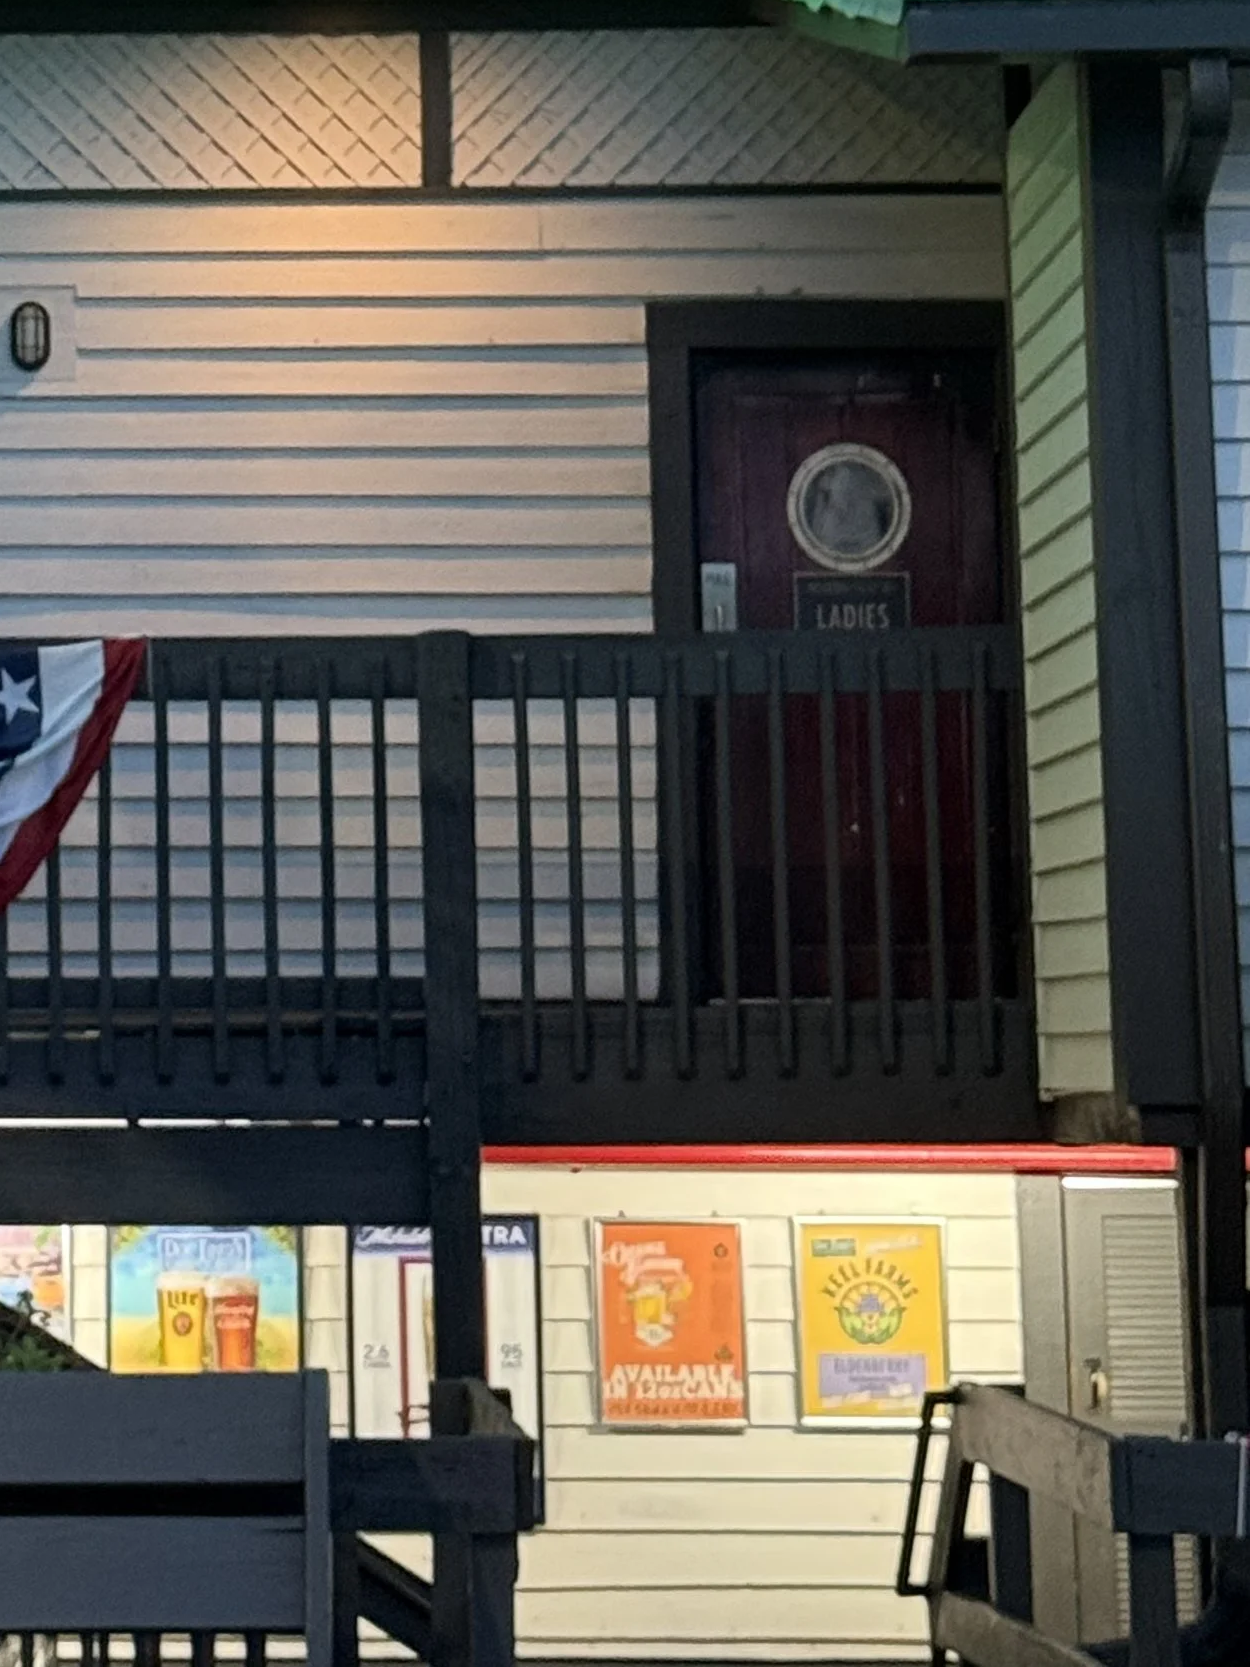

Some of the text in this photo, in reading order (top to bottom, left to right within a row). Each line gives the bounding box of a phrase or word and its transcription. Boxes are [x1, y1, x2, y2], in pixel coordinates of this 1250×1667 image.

[816, 603, 890, 630] LADIES
[481, 1223, 527, 1245] TRA
[612, 1364, 735, 1382] AVAILABLE
